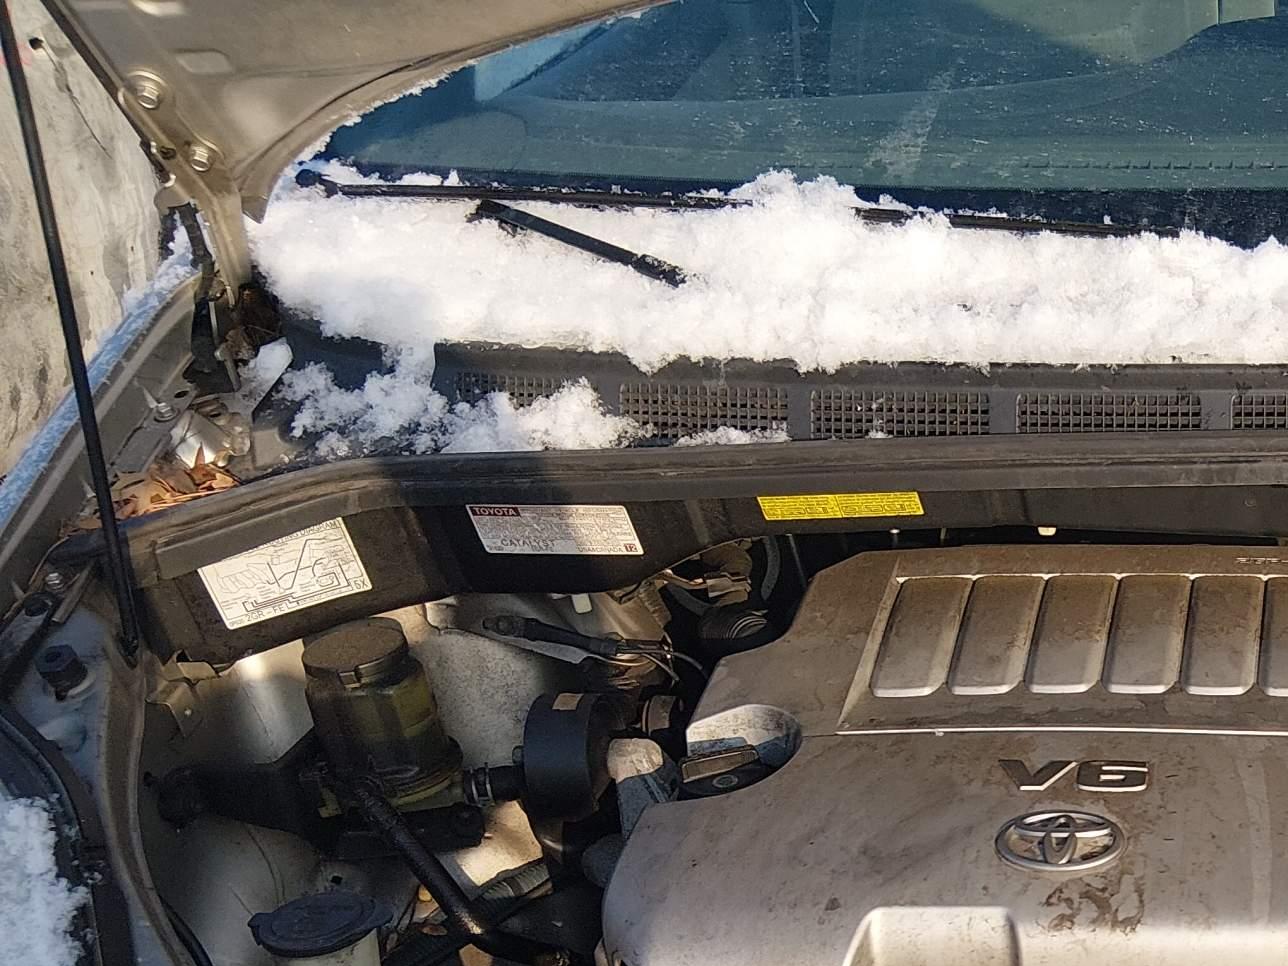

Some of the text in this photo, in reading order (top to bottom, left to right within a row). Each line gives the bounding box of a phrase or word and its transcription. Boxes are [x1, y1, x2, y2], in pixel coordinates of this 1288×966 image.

[473, 507, 517, 516] TOYOTA
[501, 539, 555, 548] CATALYST
[998, 759, 1149, 792] V6
